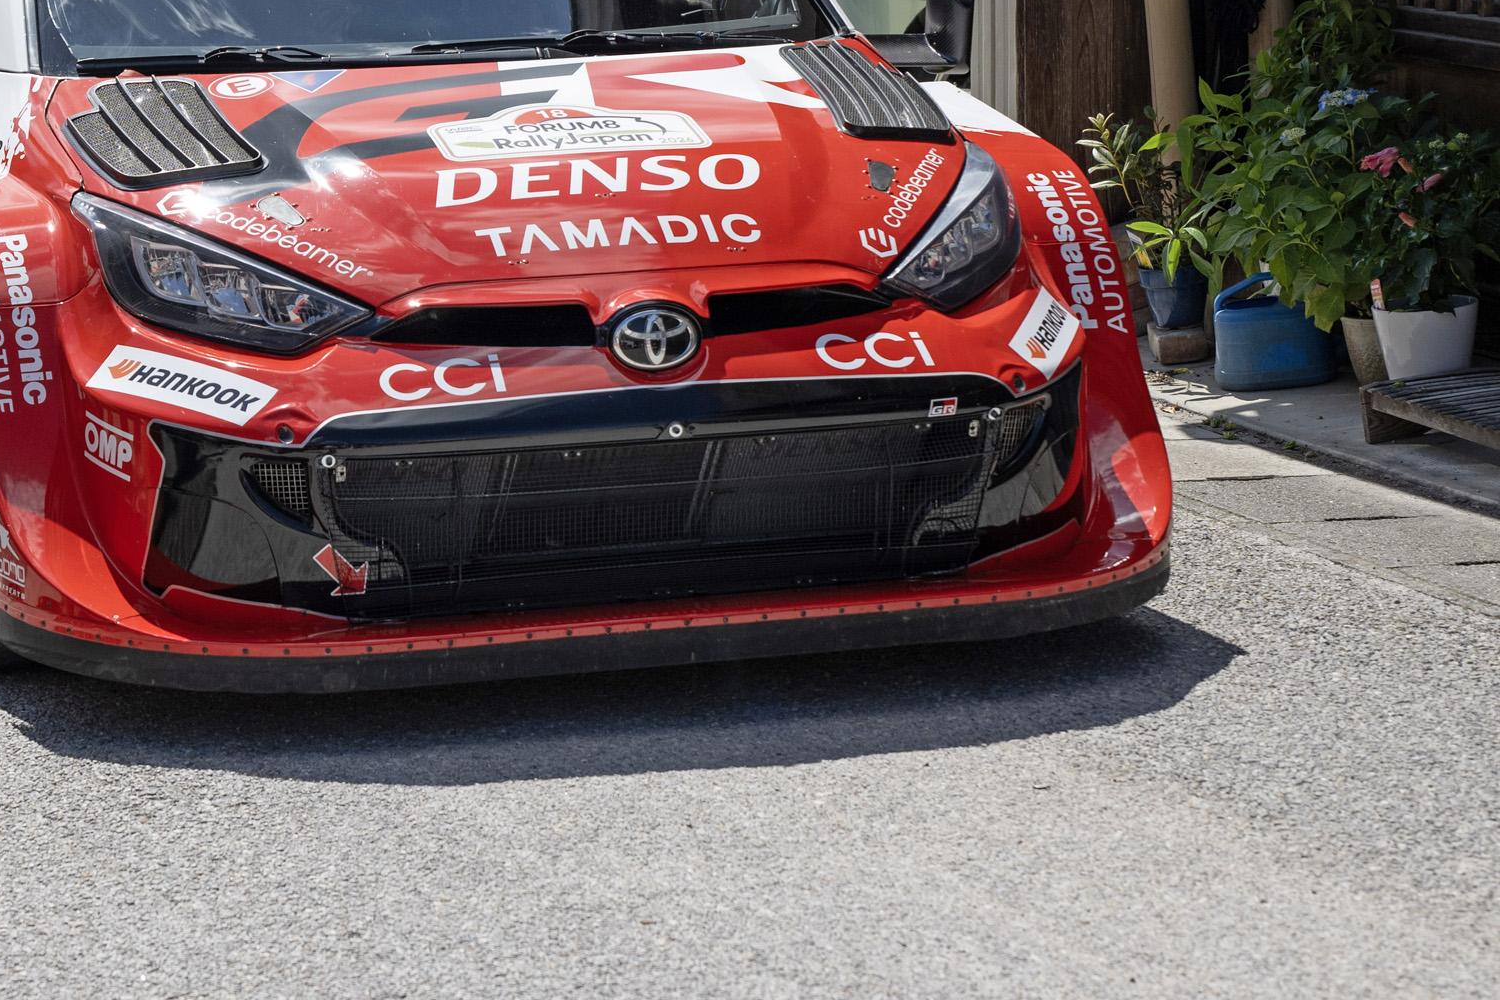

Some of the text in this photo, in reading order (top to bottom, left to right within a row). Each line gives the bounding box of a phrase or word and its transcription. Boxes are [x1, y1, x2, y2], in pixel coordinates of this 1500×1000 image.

[226, 78, 257, 94] E
[503, 119, 621, 135] FORUM8
[535, 108, 569, 120] 18
[658, 136, 695, 145] 2026
[434, 153, 761, 208] DENSO
[474, 213, 762, 257] TAMADIC
[1026, 172, 1099, 330] Panasonic
[1052, 169, 1129, 334] AUTOMOTIVE
[930, 403, 956, 415] GR
[84, 421, 133, 469] OMP
